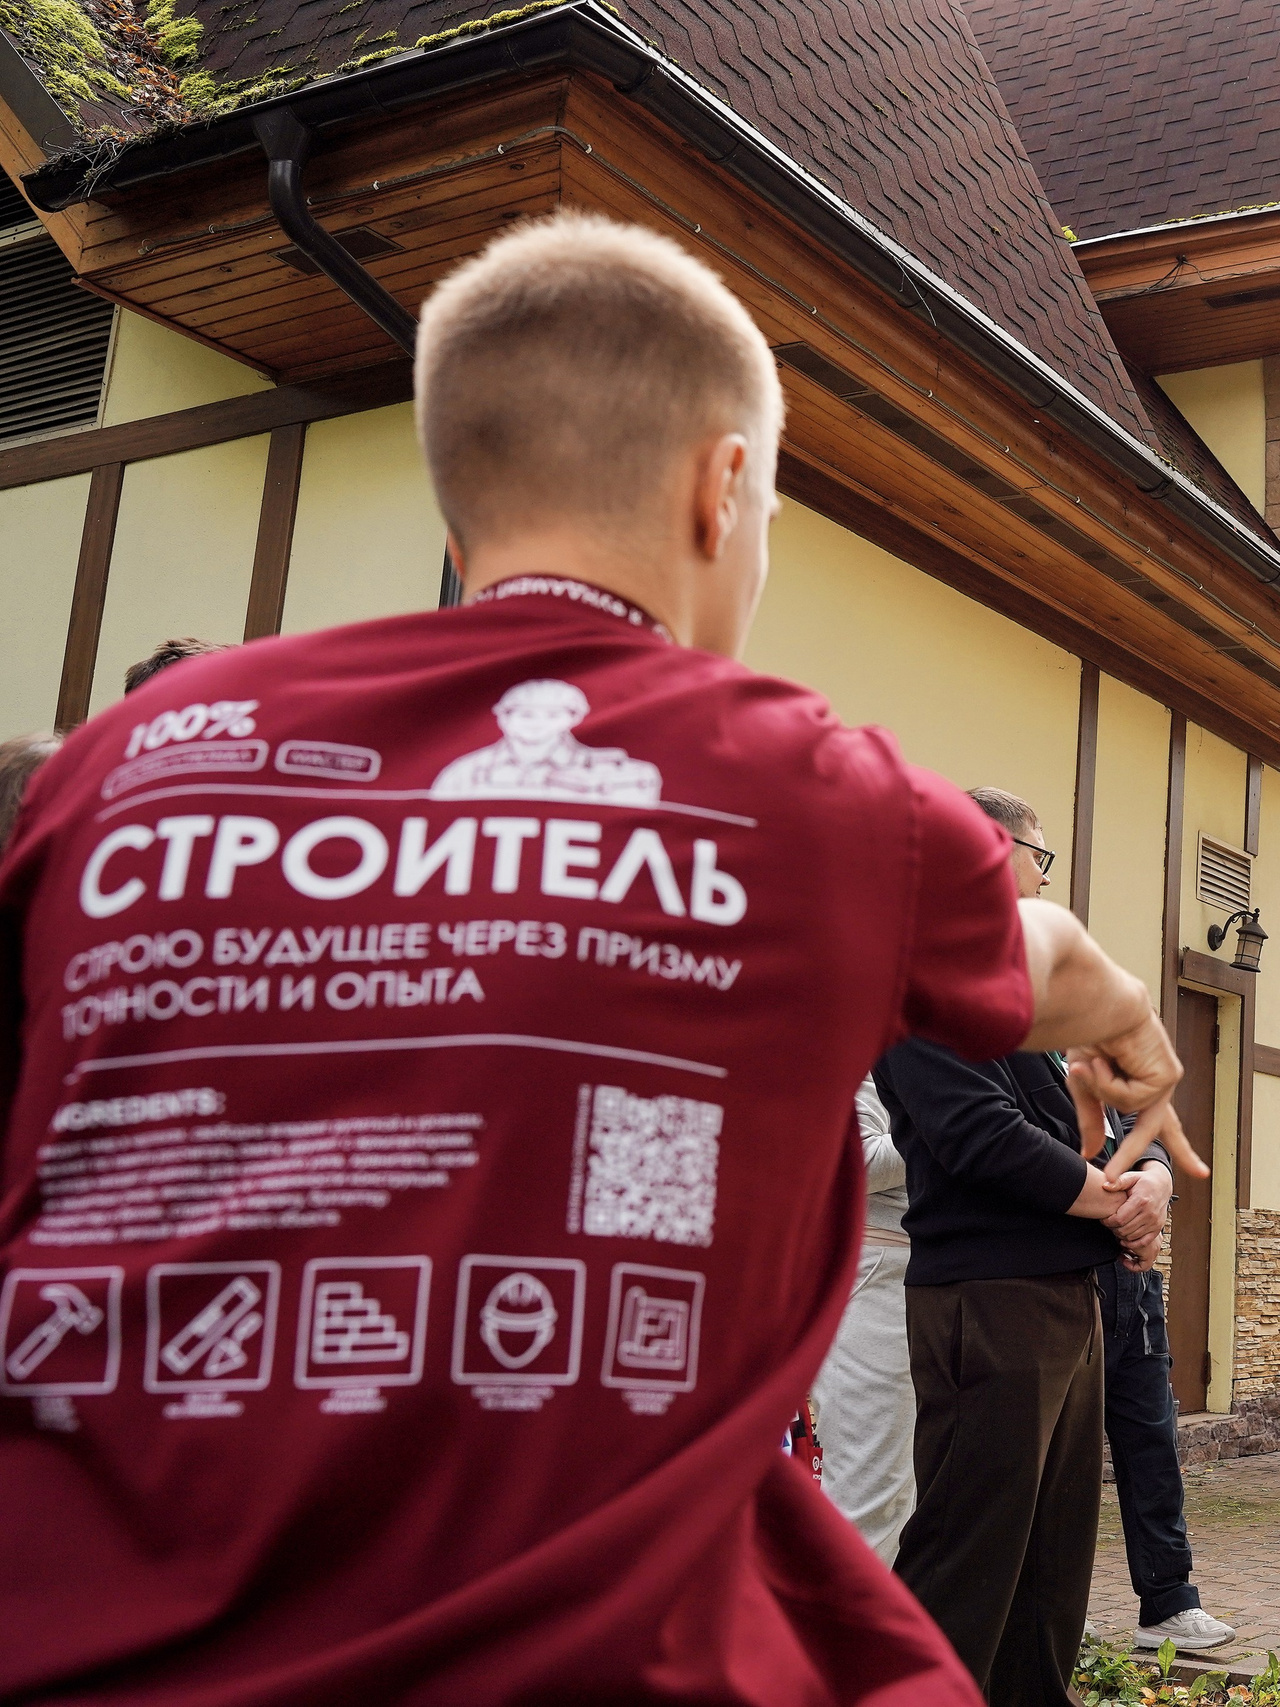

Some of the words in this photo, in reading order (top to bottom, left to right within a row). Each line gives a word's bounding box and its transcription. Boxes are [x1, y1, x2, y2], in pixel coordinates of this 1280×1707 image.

[124, 699, 260, 759] 100%
[79, 814, 748, 926] СТРОИТЕЛЬ
[64, 927, 204, 993] СТРОЮ
[212, 922, 432, 967] БУДУЩЕЕ
[437, 919, 568, 959] ЧЕРЕЗ
[576, 925, 744, 991] ПРИЗМУ
[61, 974, 271, 1041] ТОЧНОСТИ
[279, 973, 316, 1012] И
[324, 966, 486, 1011] ОПЫТА
